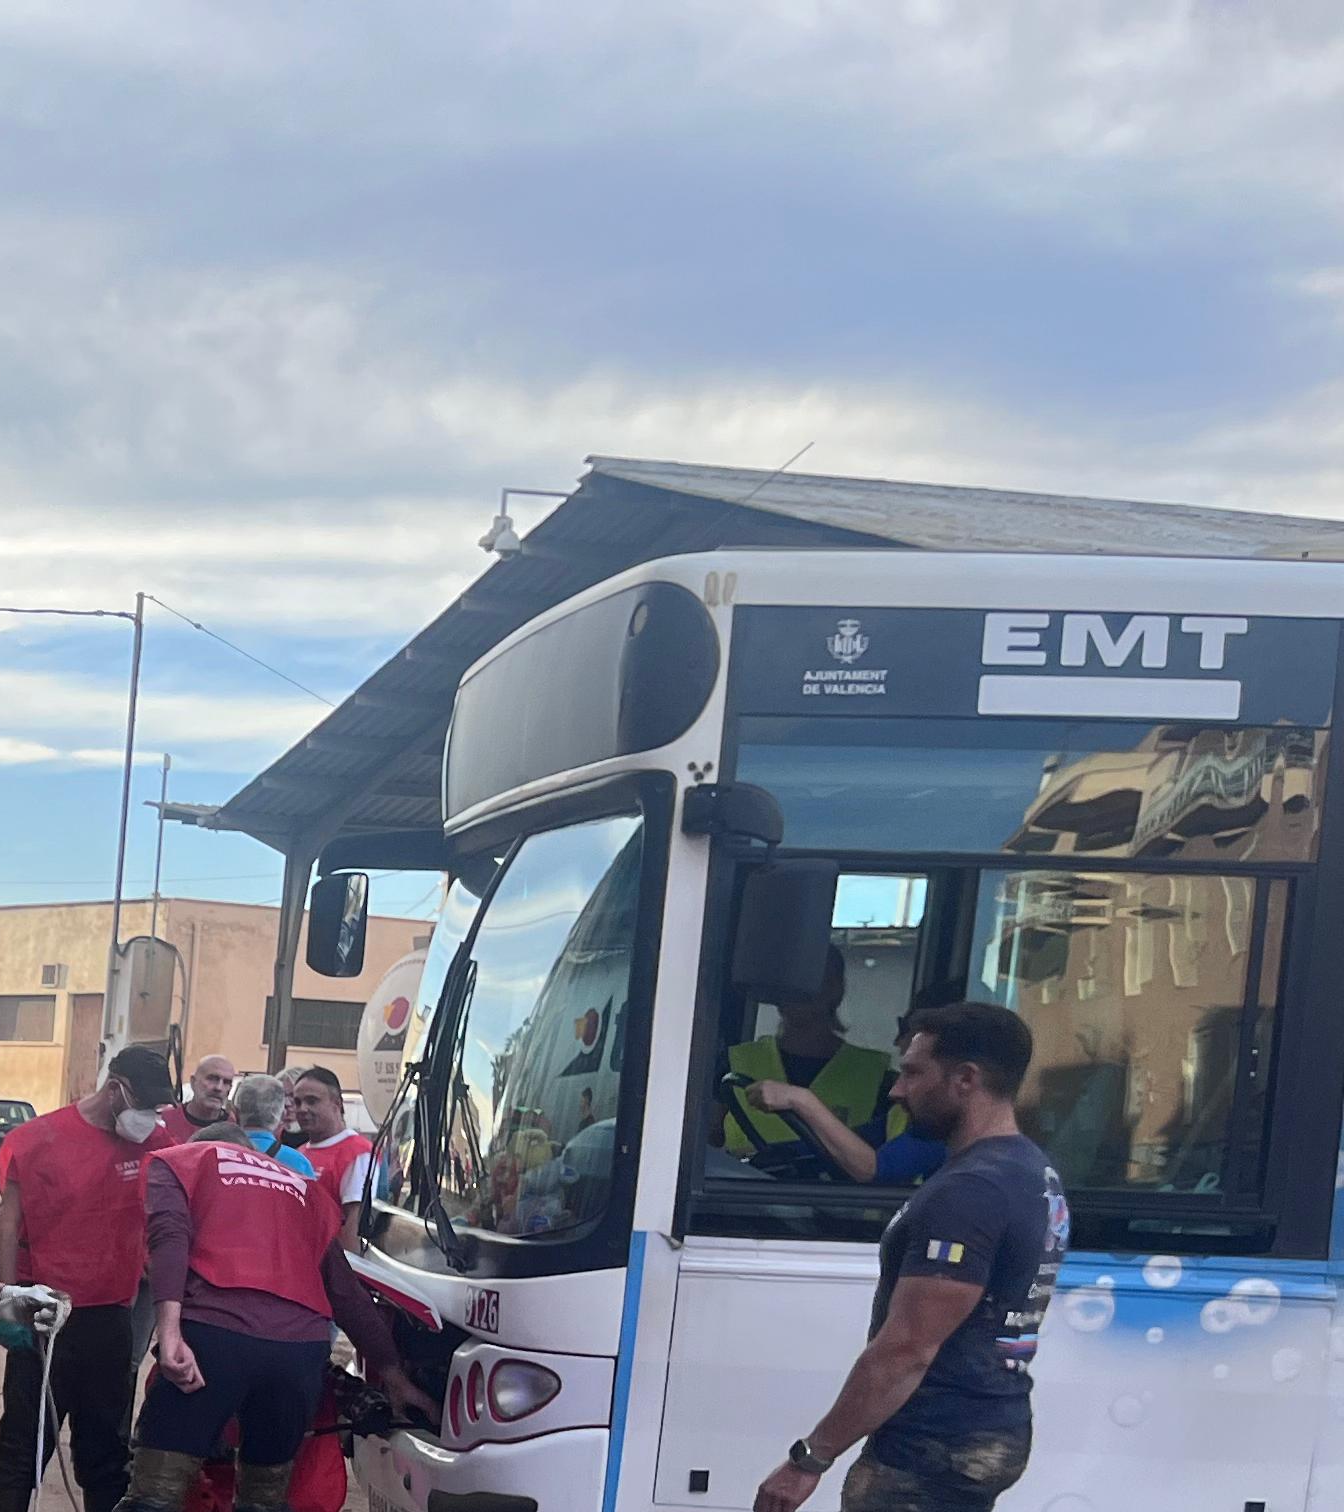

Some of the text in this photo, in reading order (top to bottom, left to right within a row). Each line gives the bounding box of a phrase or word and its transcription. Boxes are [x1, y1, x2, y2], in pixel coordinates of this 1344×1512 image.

[981, 612, 1249, 670] EMT
[803, 669, 889, 682] AJUNTAMENT
[802, 683, 821, 696] DE
